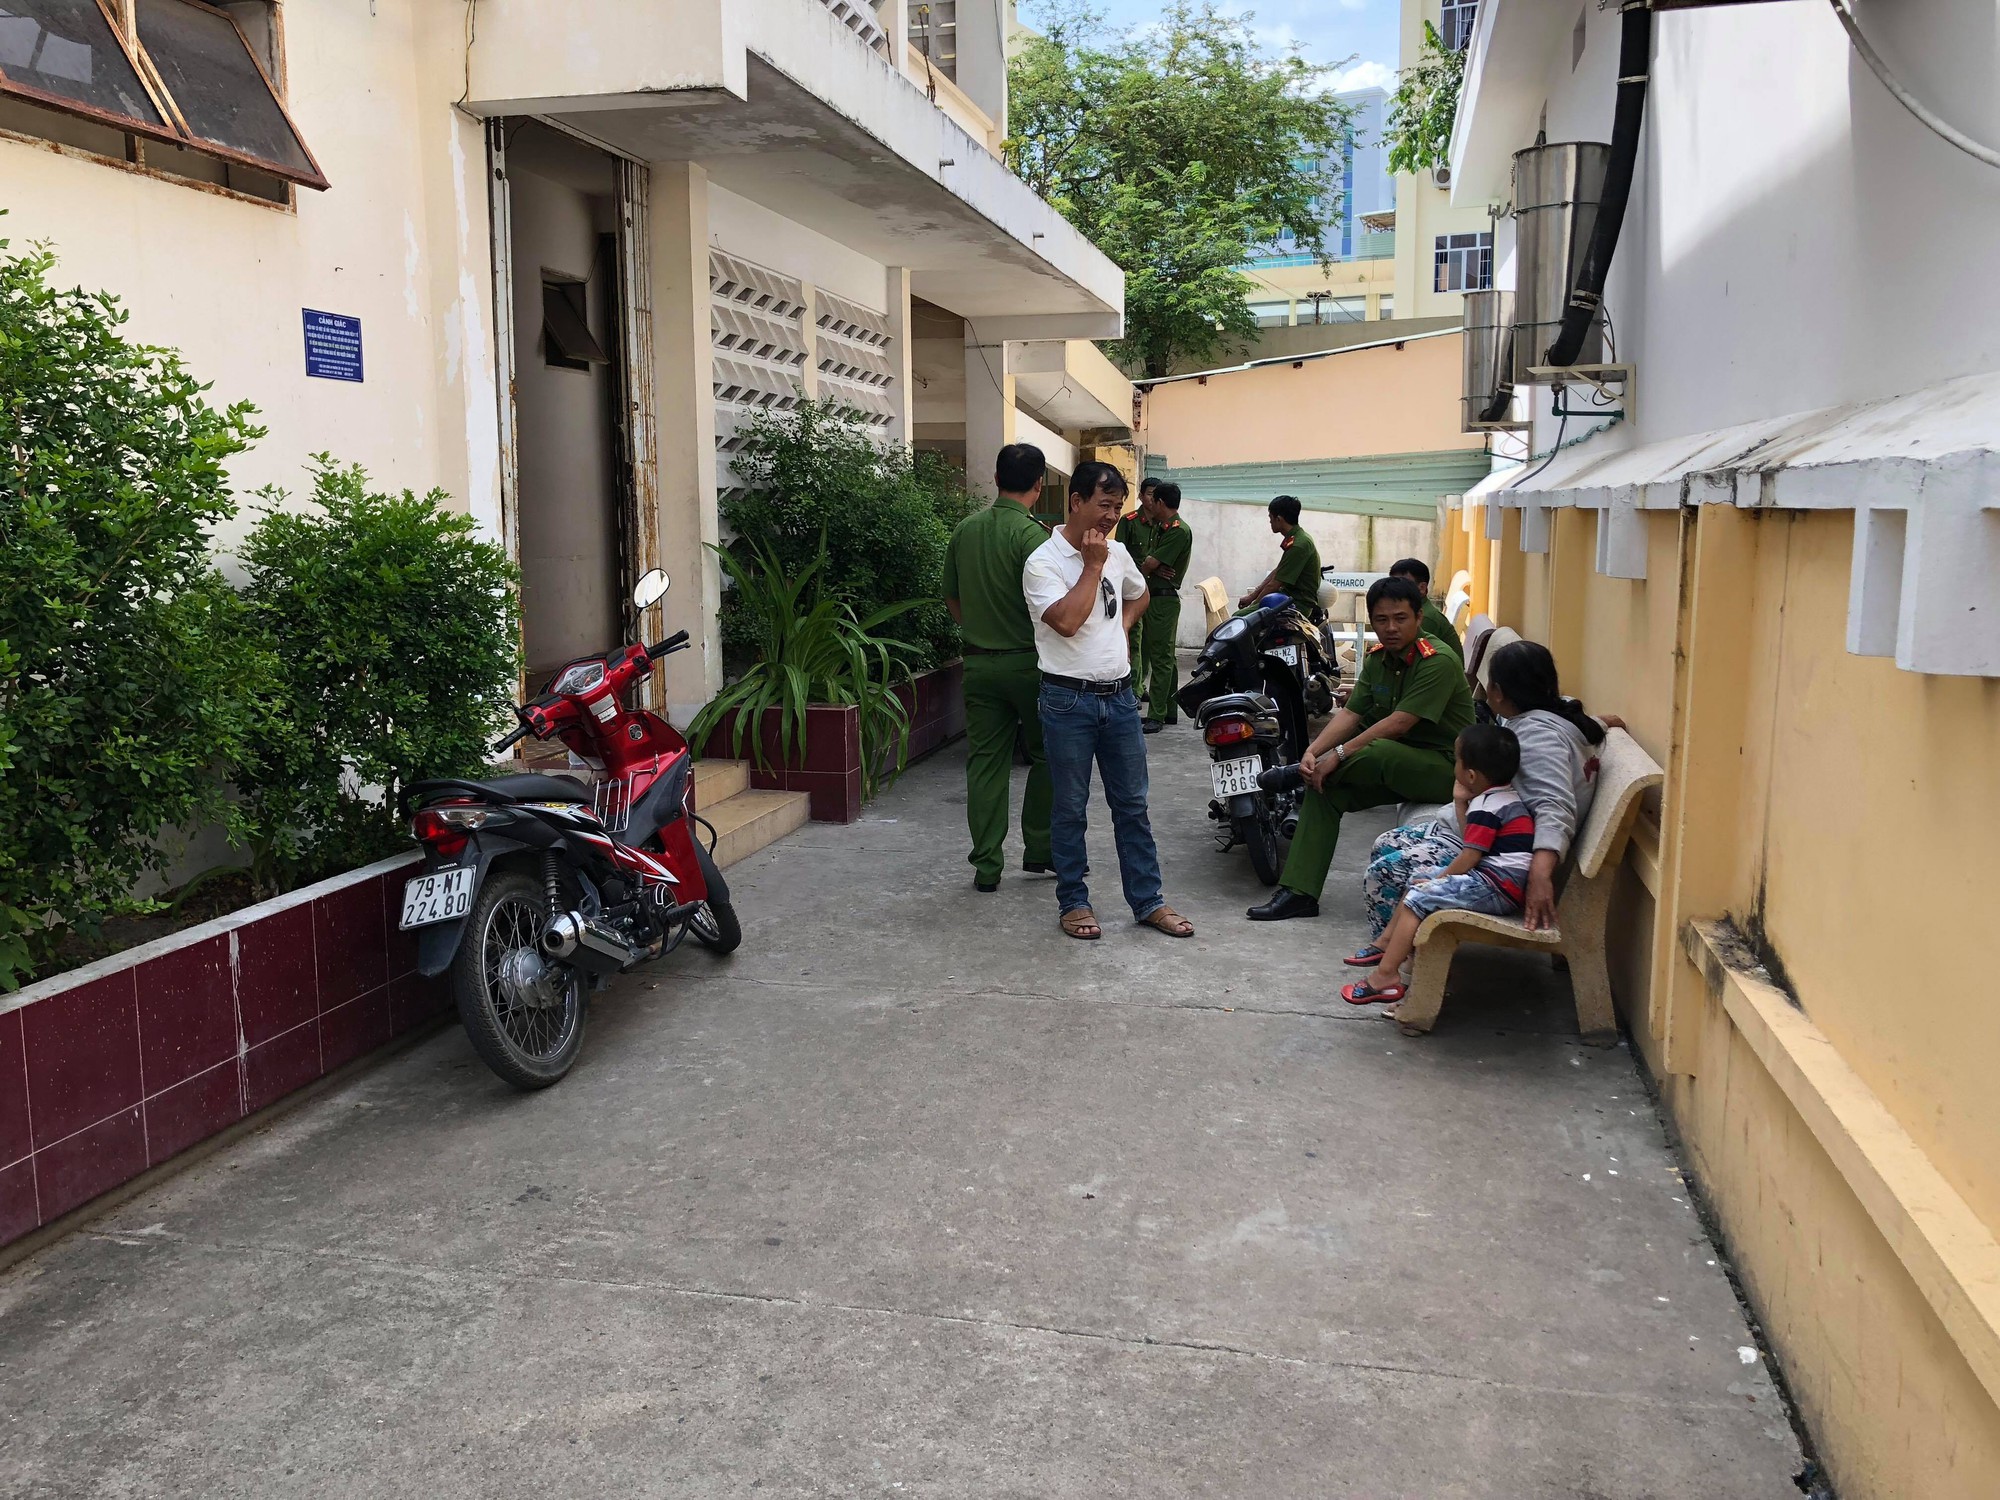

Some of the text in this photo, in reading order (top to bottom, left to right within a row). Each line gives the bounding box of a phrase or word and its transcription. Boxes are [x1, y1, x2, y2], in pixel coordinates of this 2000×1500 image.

[1218, 759, 1253, 778] 79-F7
[1220, 775, 1257, 794] 2869
[415, 871, 463, 901] 79-N1
[404, 893, 467, 925] 224.80
